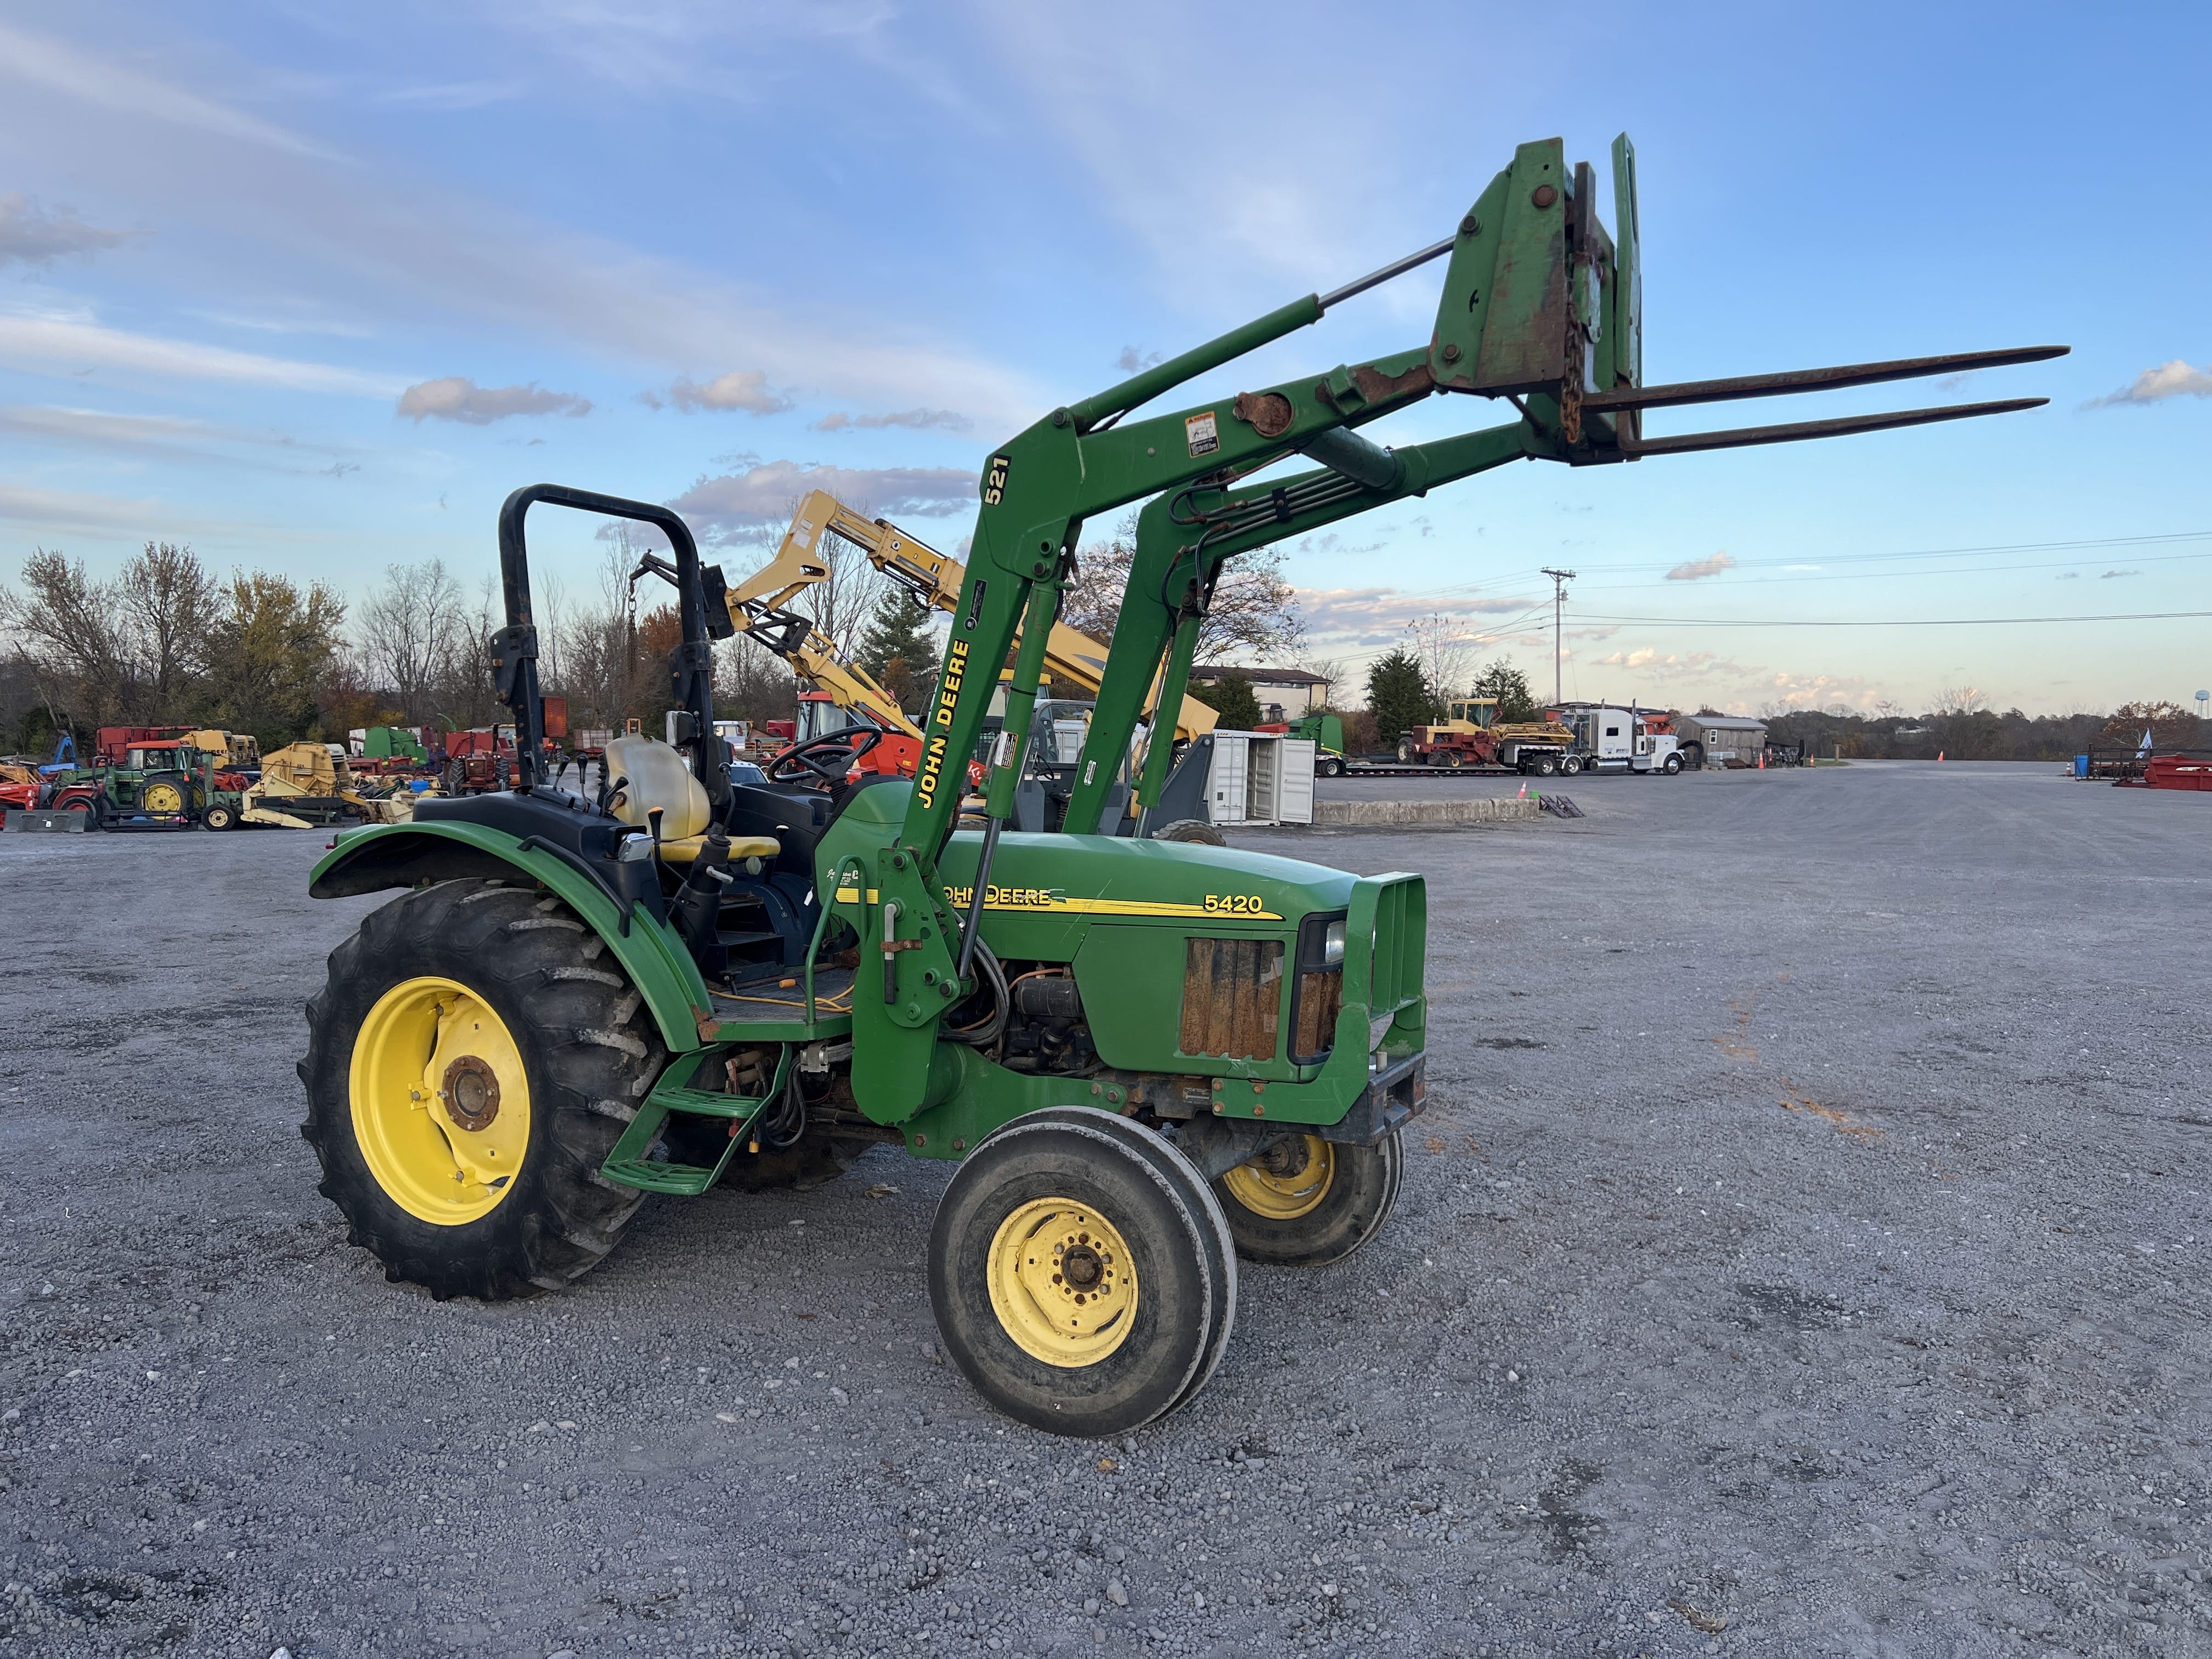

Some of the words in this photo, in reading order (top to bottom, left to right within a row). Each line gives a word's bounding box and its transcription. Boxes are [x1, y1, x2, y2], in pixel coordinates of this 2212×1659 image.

[984, 456, 1010, 506] 521
[918, 737, 947, 810] JOHN
[936, 639, 969, 726] DEERE
[984, 884, 1051, 906] DEERE
[1204, 894, 1263, 913] 5420
